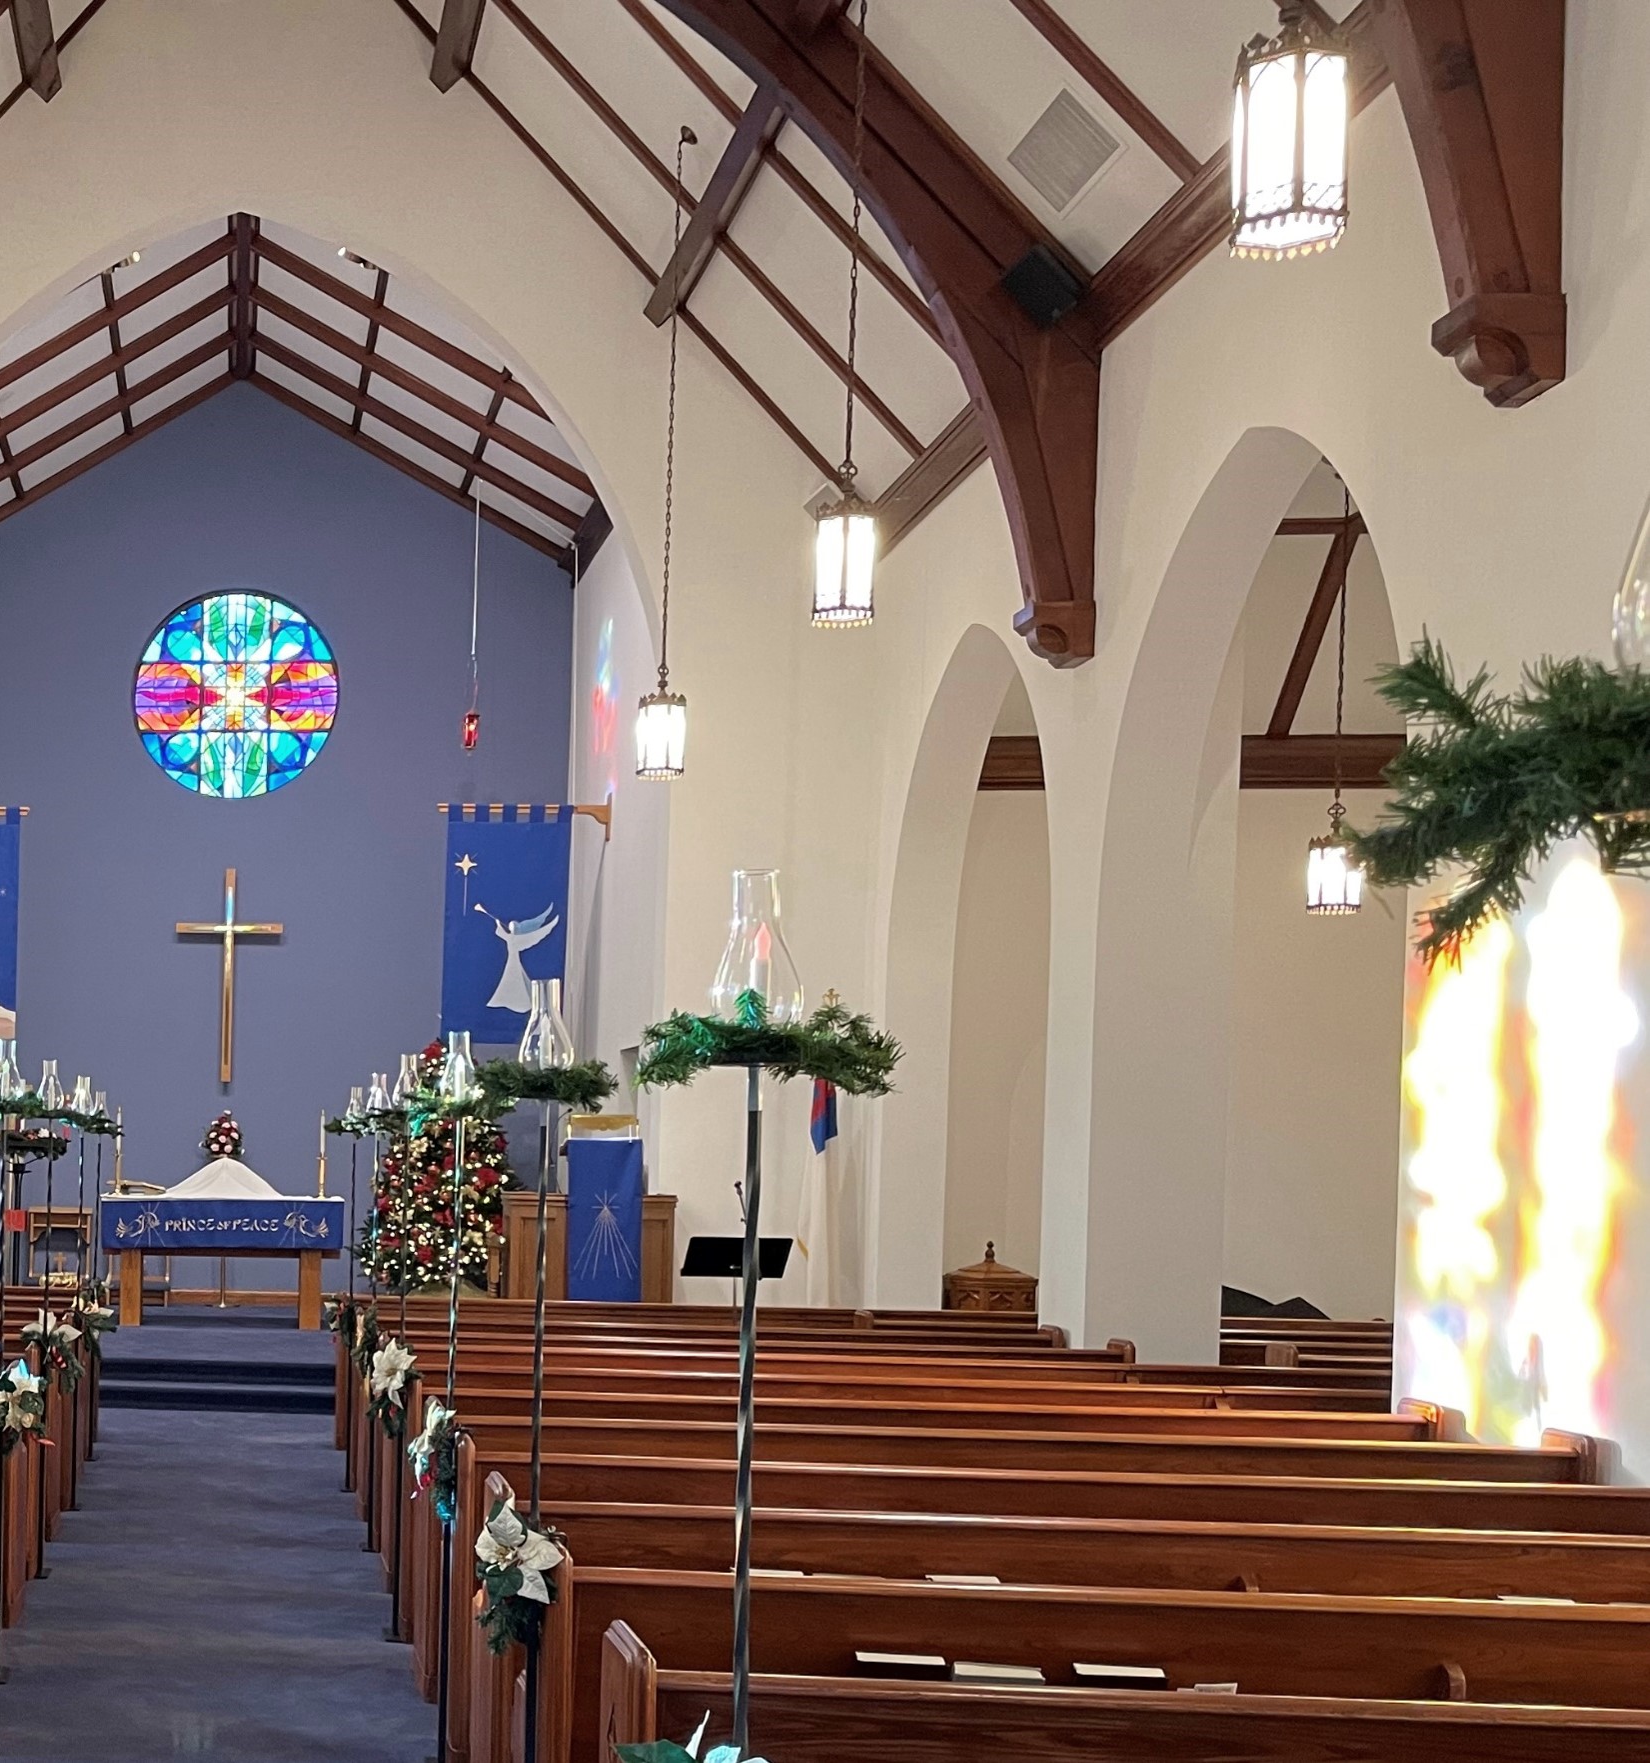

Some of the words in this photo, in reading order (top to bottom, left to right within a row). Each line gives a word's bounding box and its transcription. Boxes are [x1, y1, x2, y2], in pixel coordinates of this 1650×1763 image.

[164, 1217, 215, 1232] PRINCE
[216, 1220, 232, 1231] OF
[232, 1218, 279, 1232] PEACE
